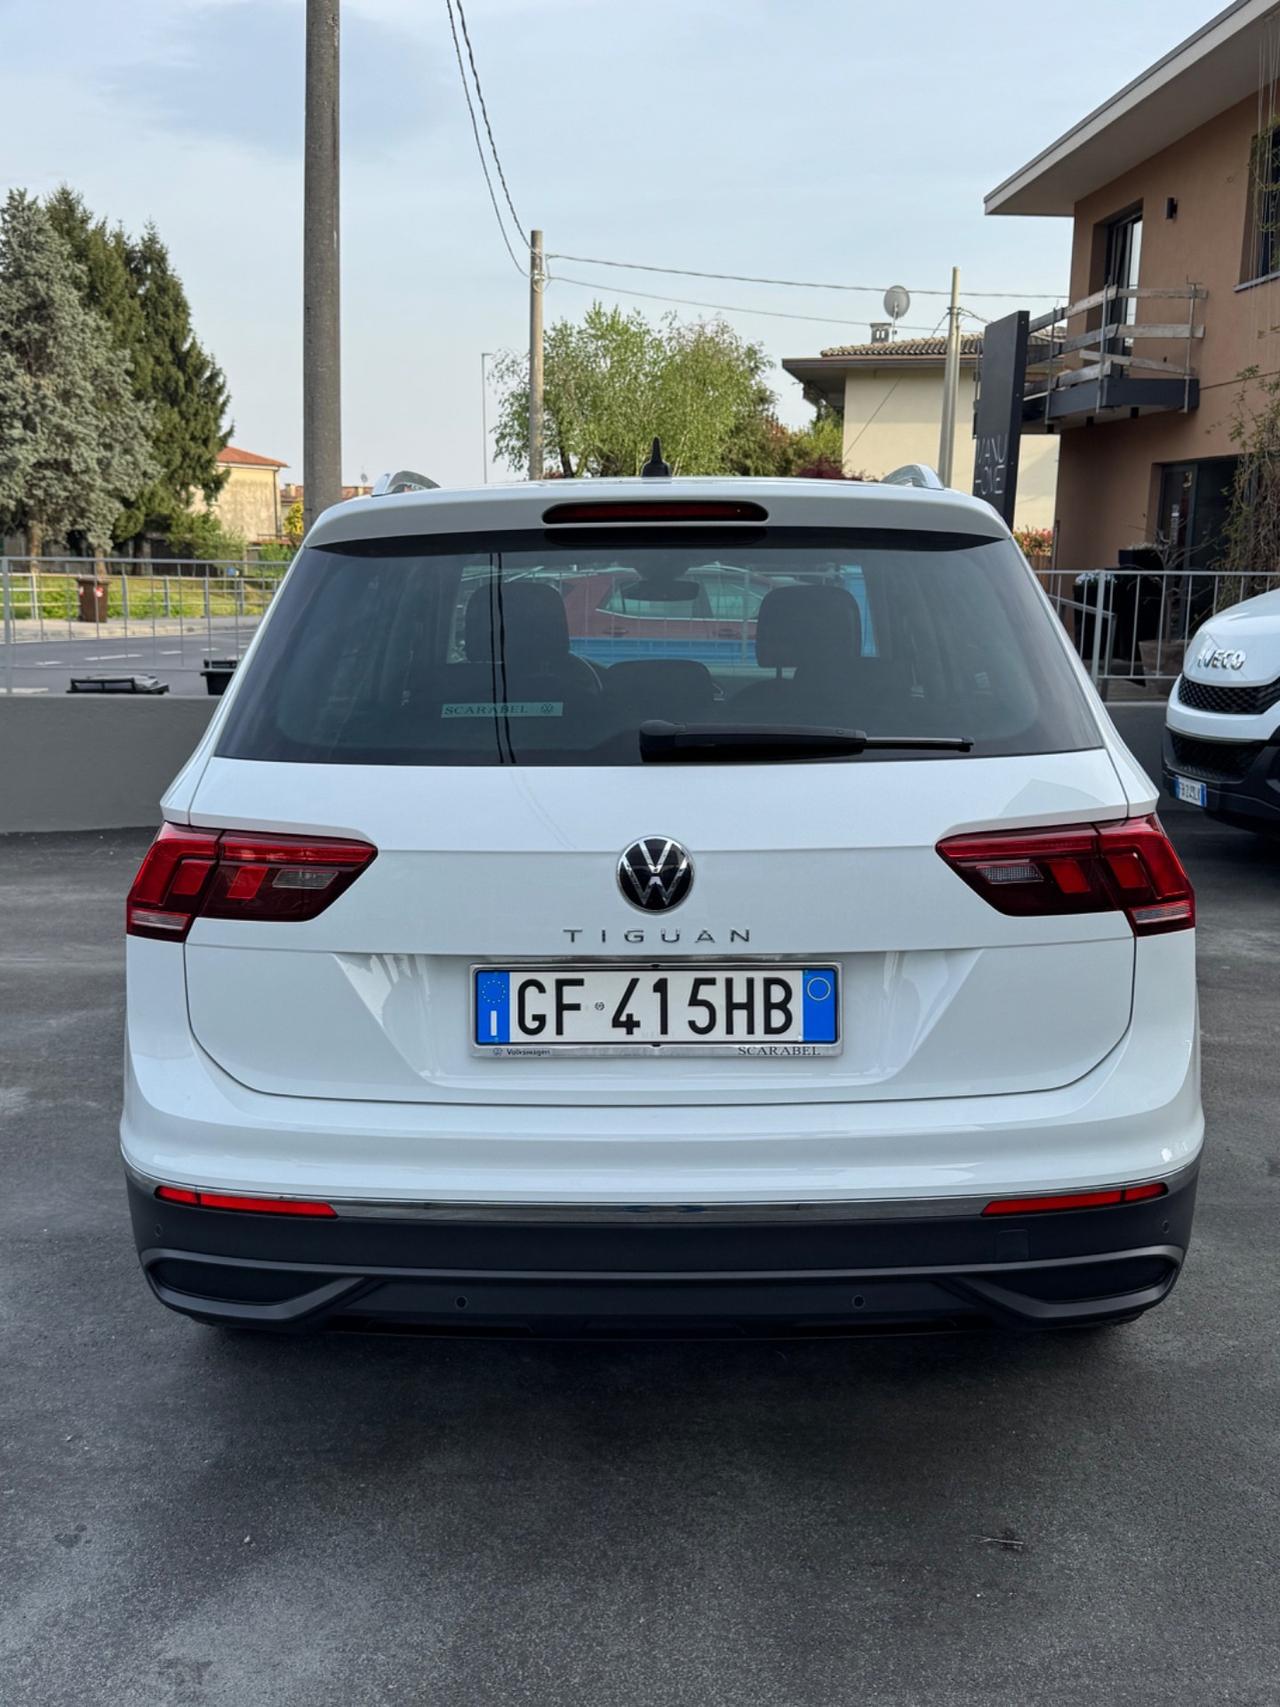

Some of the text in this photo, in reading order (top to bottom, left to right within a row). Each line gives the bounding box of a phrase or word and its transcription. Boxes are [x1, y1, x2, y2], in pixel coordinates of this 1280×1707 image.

[1197, 649, 1246, 671] IVECO
[444, 704, 528, 716] SCARABEL
[563, 928, 750, 944] TIGUAN
[506, 1047, 551, 1057] Volkswagen
[738, 1045, 821, 1056] SCARABEL
